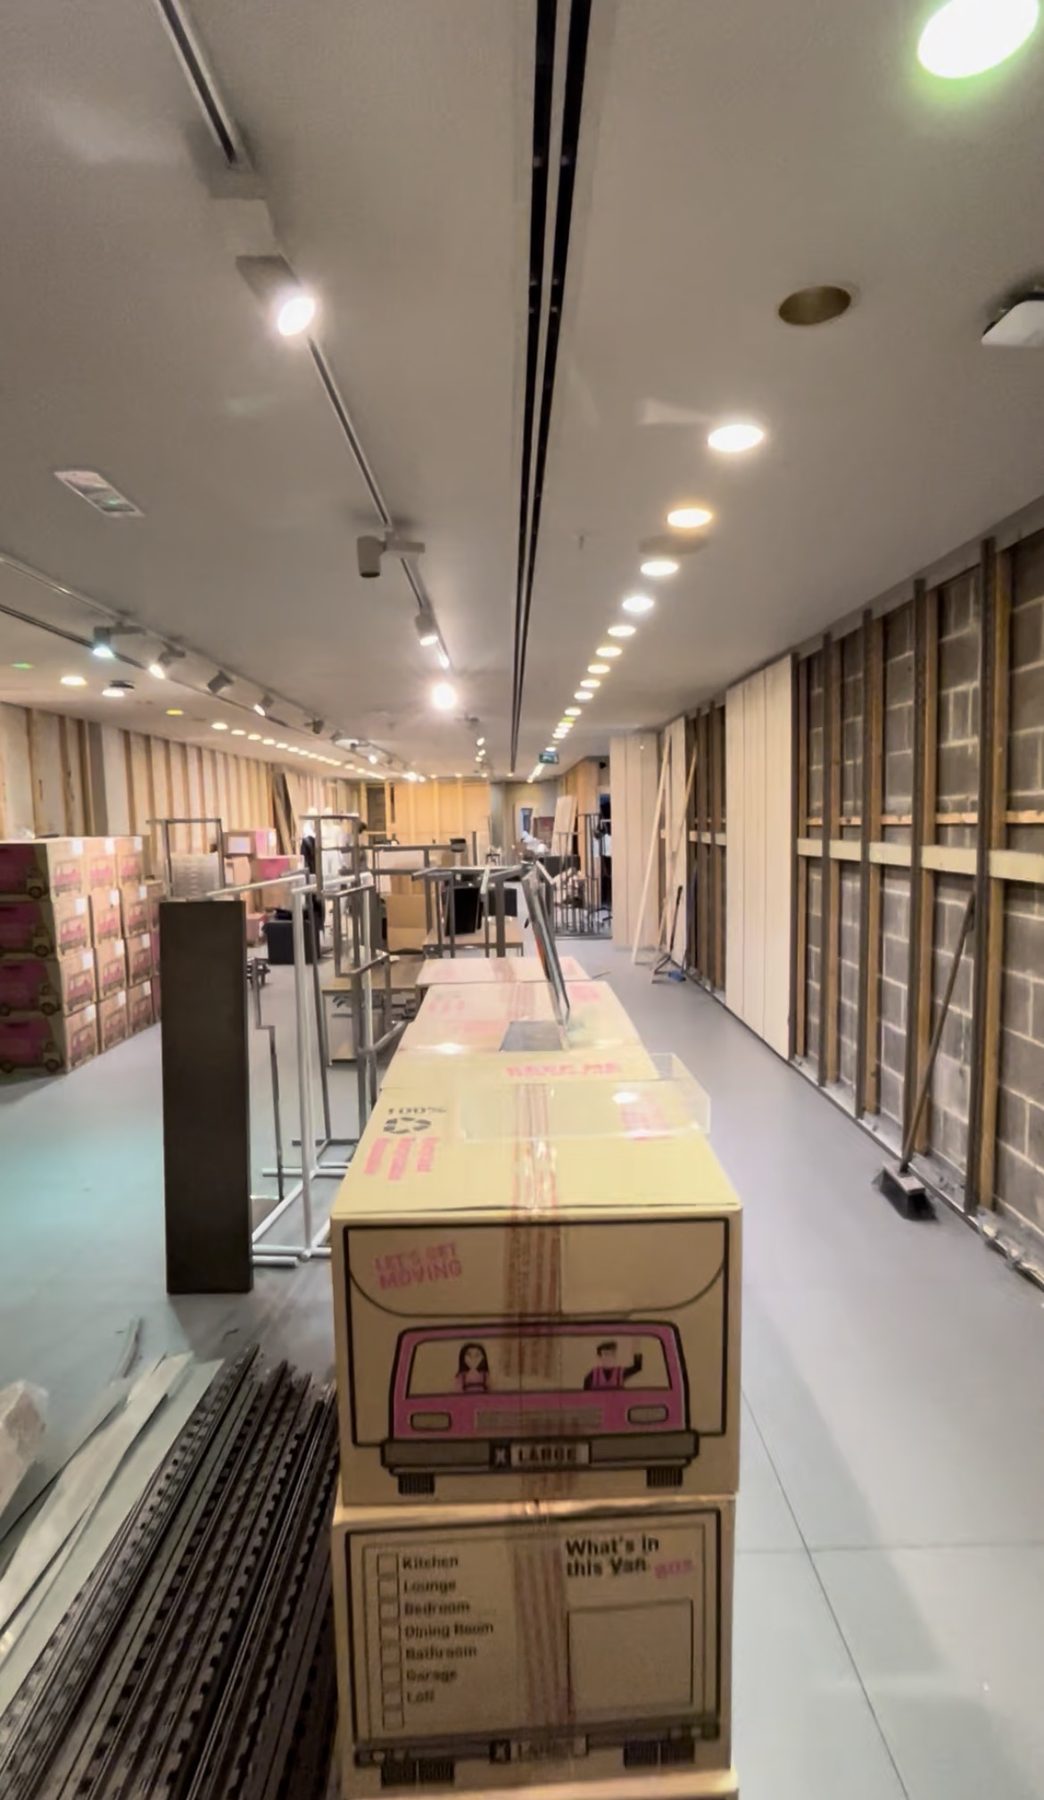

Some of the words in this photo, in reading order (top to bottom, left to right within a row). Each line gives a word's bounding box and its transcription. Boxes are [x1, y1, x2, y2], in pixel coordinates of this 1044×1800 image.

[379, 1259, 462, 1290] MOVING
[566, 1536, 635, 1556] What's
[402, 1555, 459, 1570] Kitchen
[567, 1560, 603, 1577] this
[611, 1557, 647, 1575] Van
[404, 1581, 456, 1595] Lounge
[404, 1602, 470, 1616] Bedroom
[404, 1624, 450, 1639] Dining
[453, 1622, 494, 1636] Room
[406, 1646, 477, 1660] Bathroom
[406, 1669, 457, 1683] Garage
[406, 1689, 435, 1704] Loft
